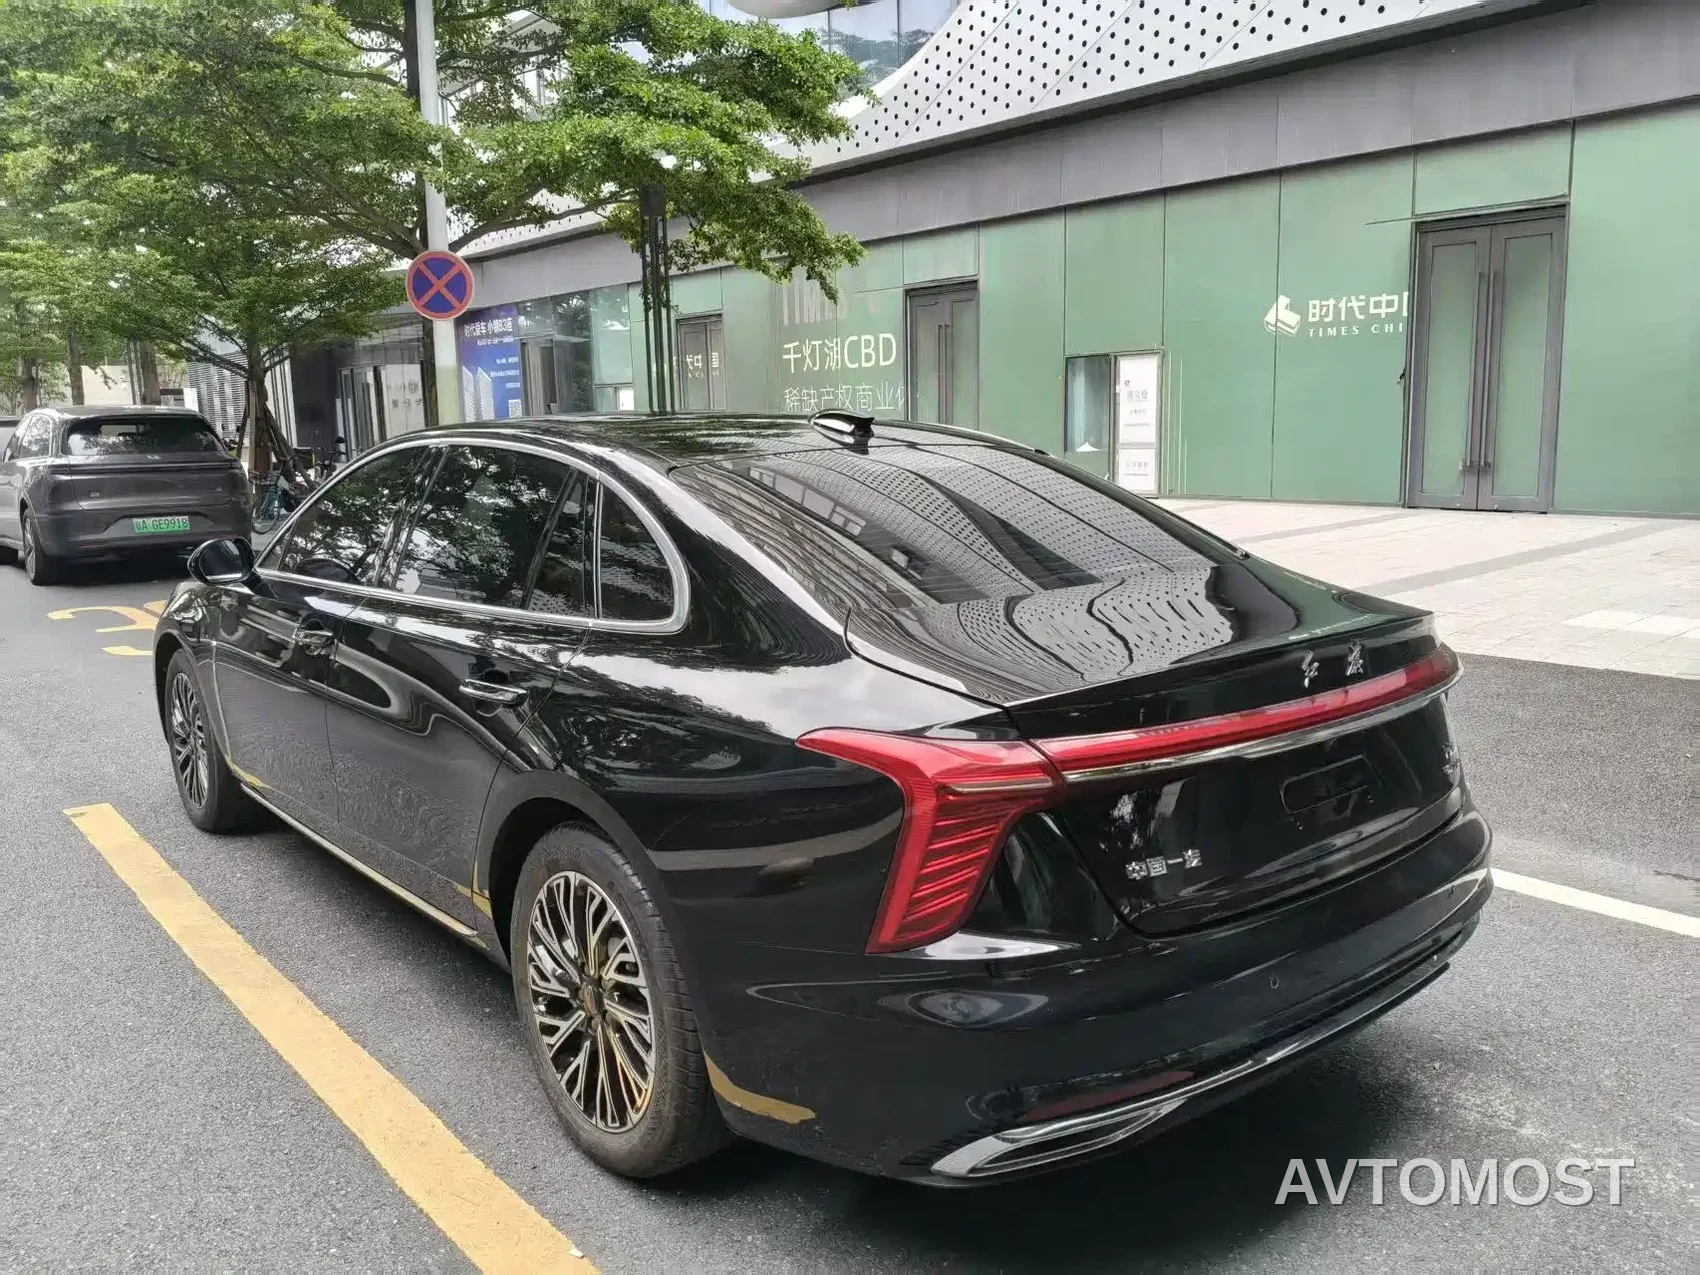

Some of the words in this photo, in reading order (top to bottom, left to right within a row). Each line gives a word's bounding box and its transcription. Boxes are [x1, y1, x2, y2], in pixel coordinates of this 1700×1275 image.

[1308, 292, 1409, 322] 时代中
[1309, 325, 1360, 338] TIMES
[783, 333, 897, 374] 千灯湖CBD
